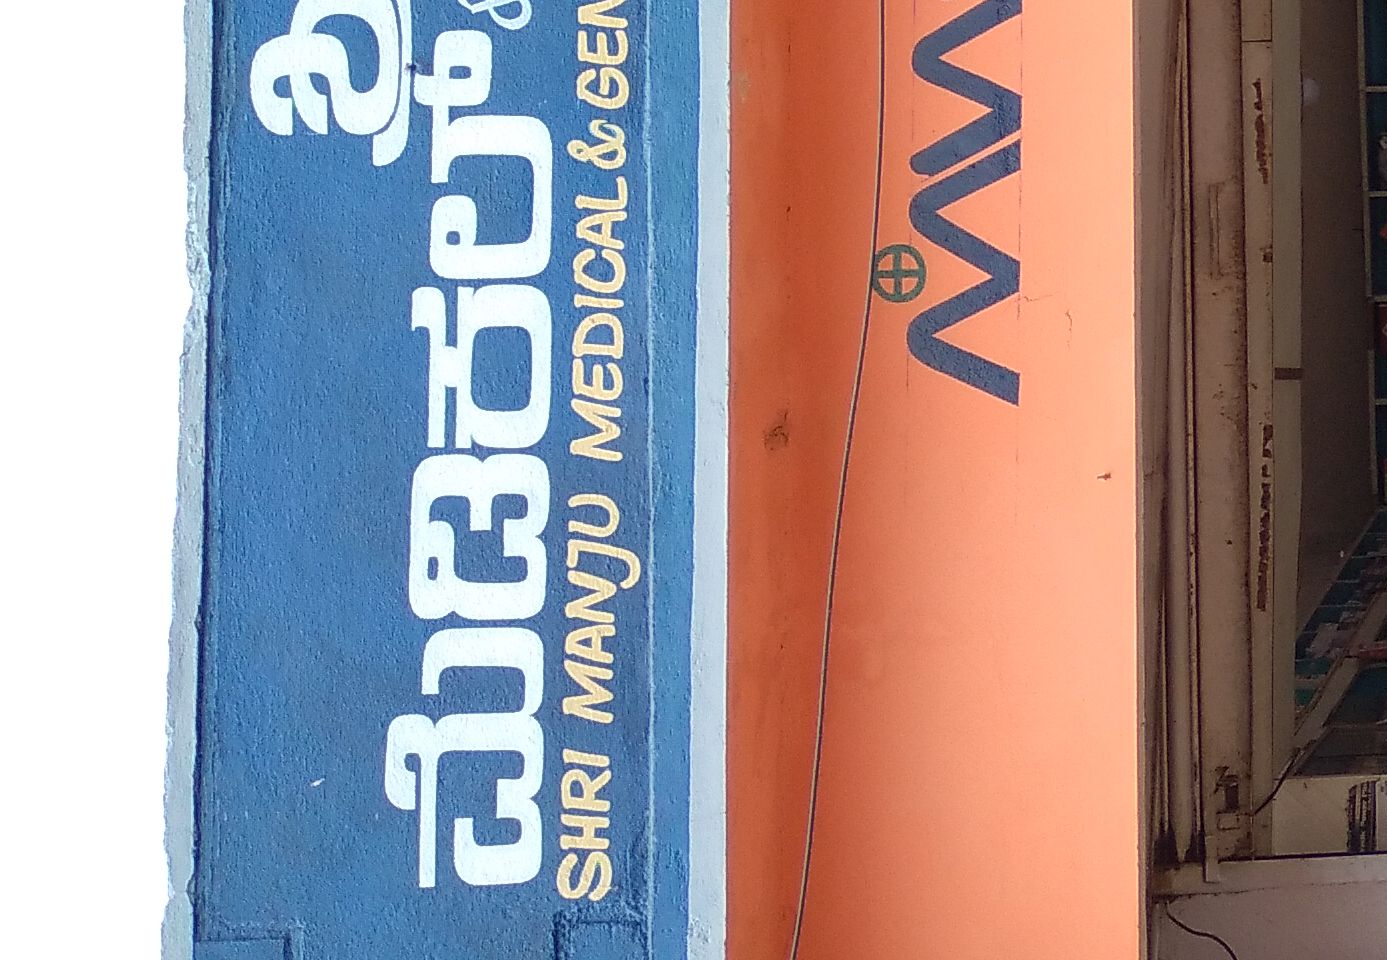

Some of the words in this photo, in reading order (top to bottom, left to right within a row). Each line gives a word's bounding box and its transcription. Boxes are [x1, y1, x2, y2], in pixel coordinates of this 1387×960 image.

[567, 119, 628, 170] &
[570, 177, 628, 461] MEDICAL
[384, 29, 553, 889] ಮೆಡಿಕಲ್
[562, 493, 641, 724] MANJU
[557, 748, 614, 901] SHRI
